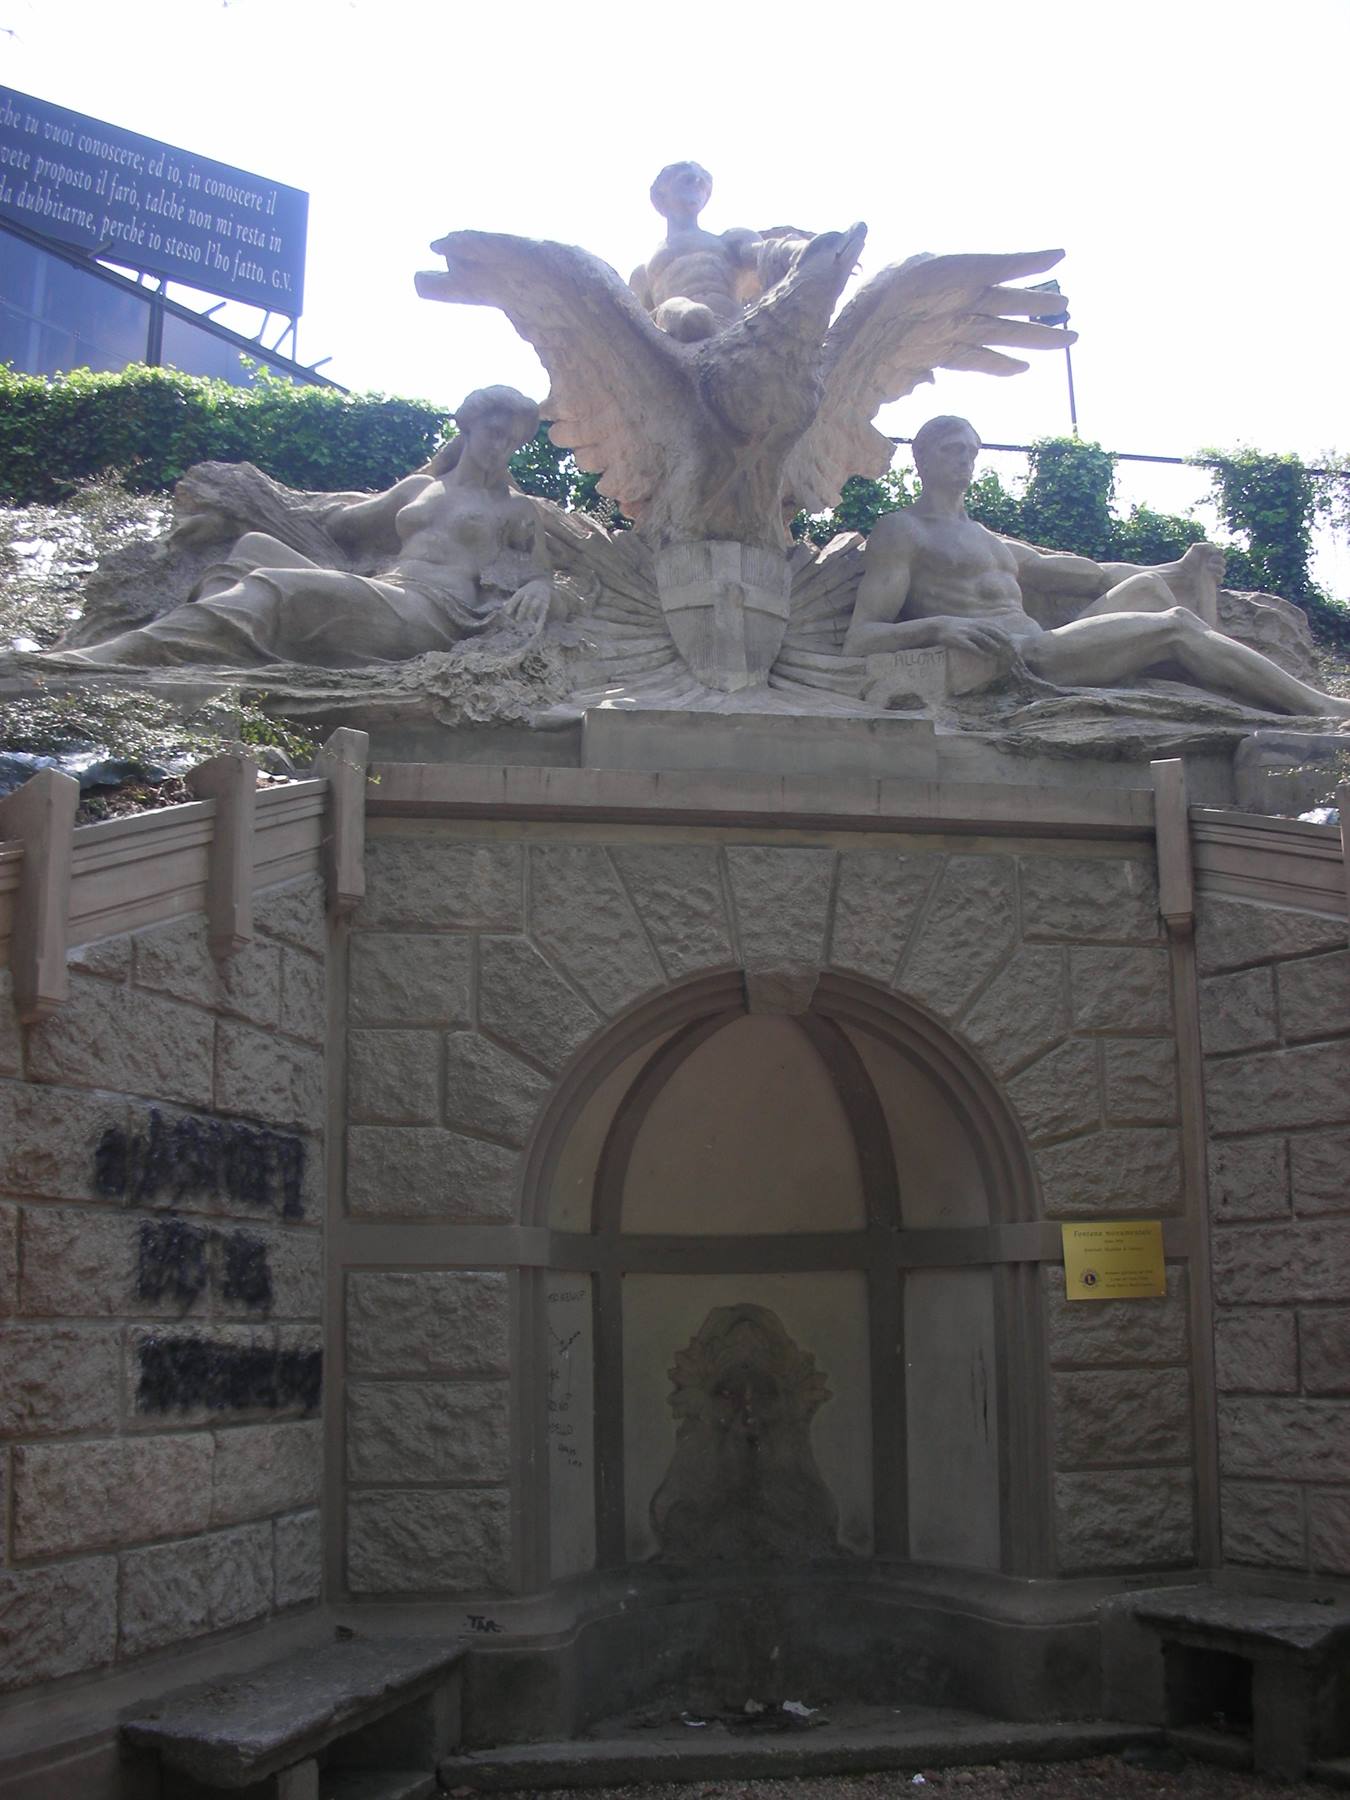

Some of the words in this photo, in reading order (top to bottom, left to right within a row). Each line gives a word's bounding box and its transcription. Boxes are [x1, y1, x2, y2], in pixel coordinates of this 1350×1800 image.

[25, 114, 39, 135] tu
[44, 122, 77, 148] vuoi
[78, 135, 145, 176] conoscere;
[148, 152, 166, 177] ed
[168, 157, 183, 189] io,
[187, 164, 201, 190] in
[205, 177, 263, 212] conoscere
[266, 190, 278, 216] il
[33, 156, 93, 191] proposto
[95, 169, 109, 196] il
[107, 173, 141, 212] farò,
[144, 188, 186, 221] talché
[188, 207, 213, 230] non
[215, 213, 234, 236] mi
[236, 223, 265, 248] resta
[269, 226, 282, 253] in
[17, 181, 97, 236] dubbitarne,
[100, 215, 147, 246] perché
[148, 223, 162, 251] io
[164, 236, 202, 264] stesso
[231, 249, 267, 285] fatto.
[271, 269, 293, 293] G.V.
